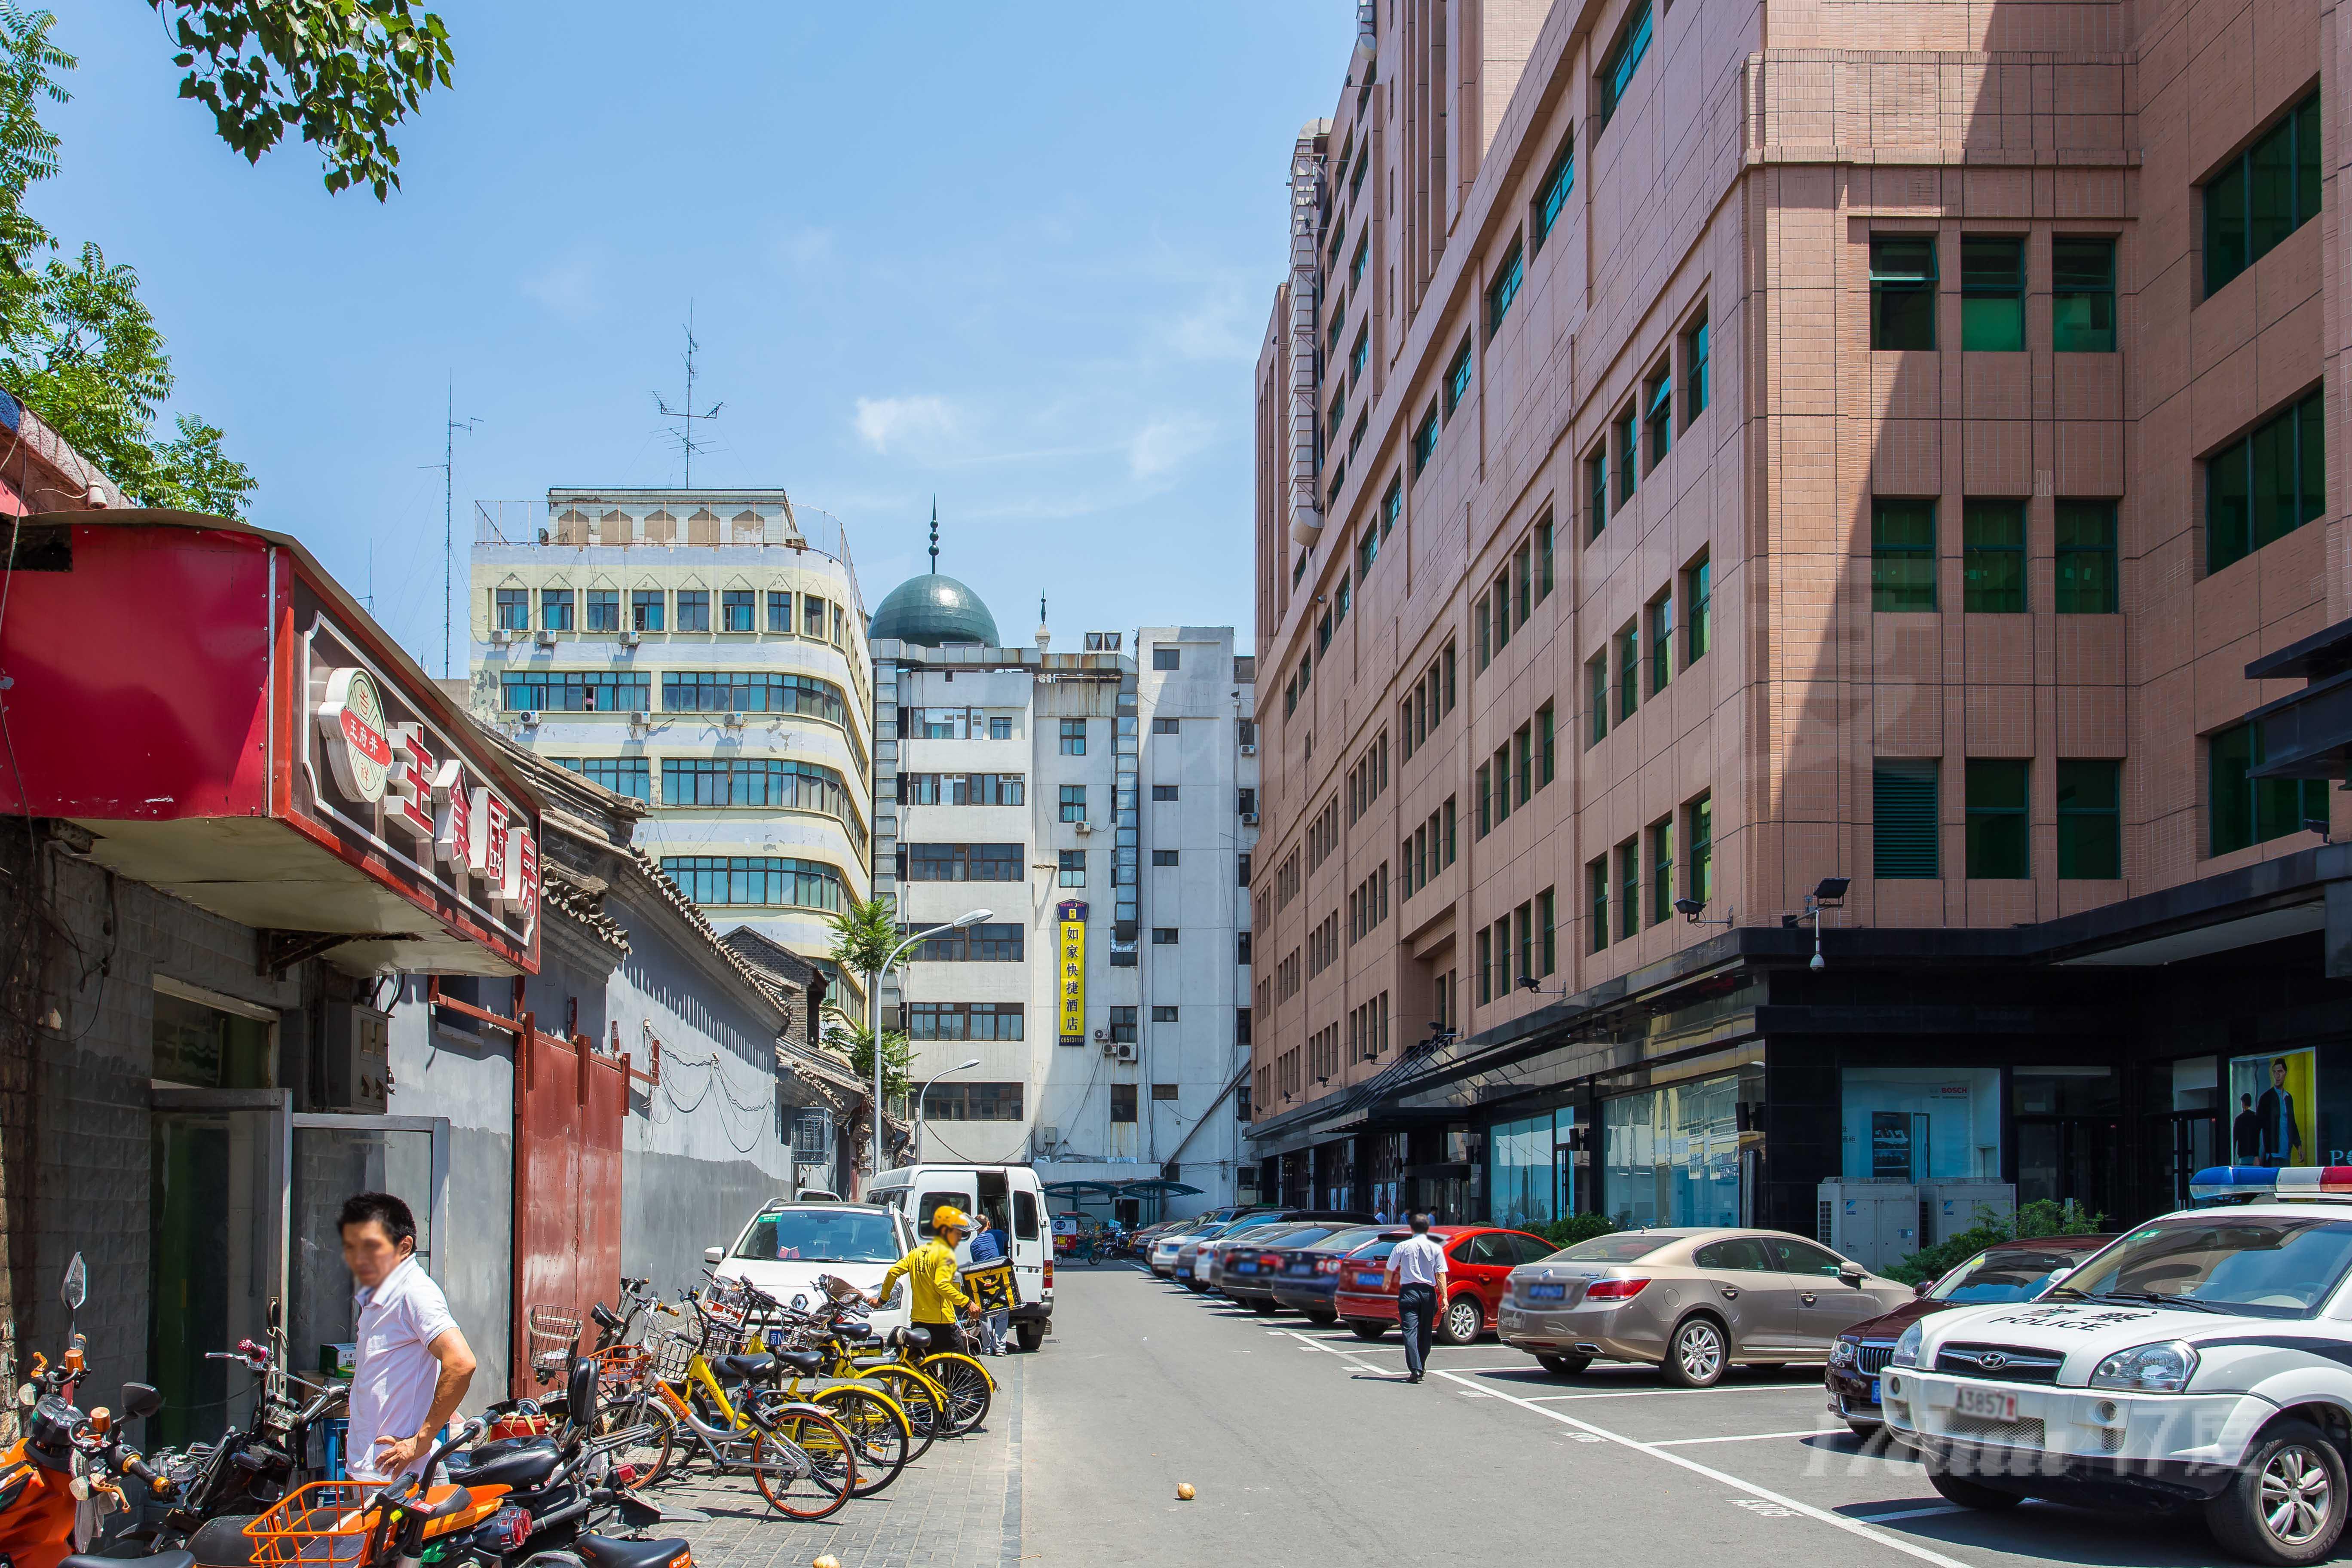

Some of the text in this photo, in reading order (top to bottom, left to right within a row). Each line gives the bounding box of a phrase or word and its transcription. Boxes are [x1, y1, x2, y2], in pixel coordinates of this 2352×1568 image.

[349, 718, 379, 756] 王府井
[393, 721, 537, 919] 主食厨房
[1066, 926, 1079, 1031] 如家快捷酒店
[1988, 1317, 2111, 1331] POLICE
[2019, 1307, 2153, 1322] 警察
[662, 1390, 686, 1417] mobike
[708, 1385, 719, 1398] ofo
